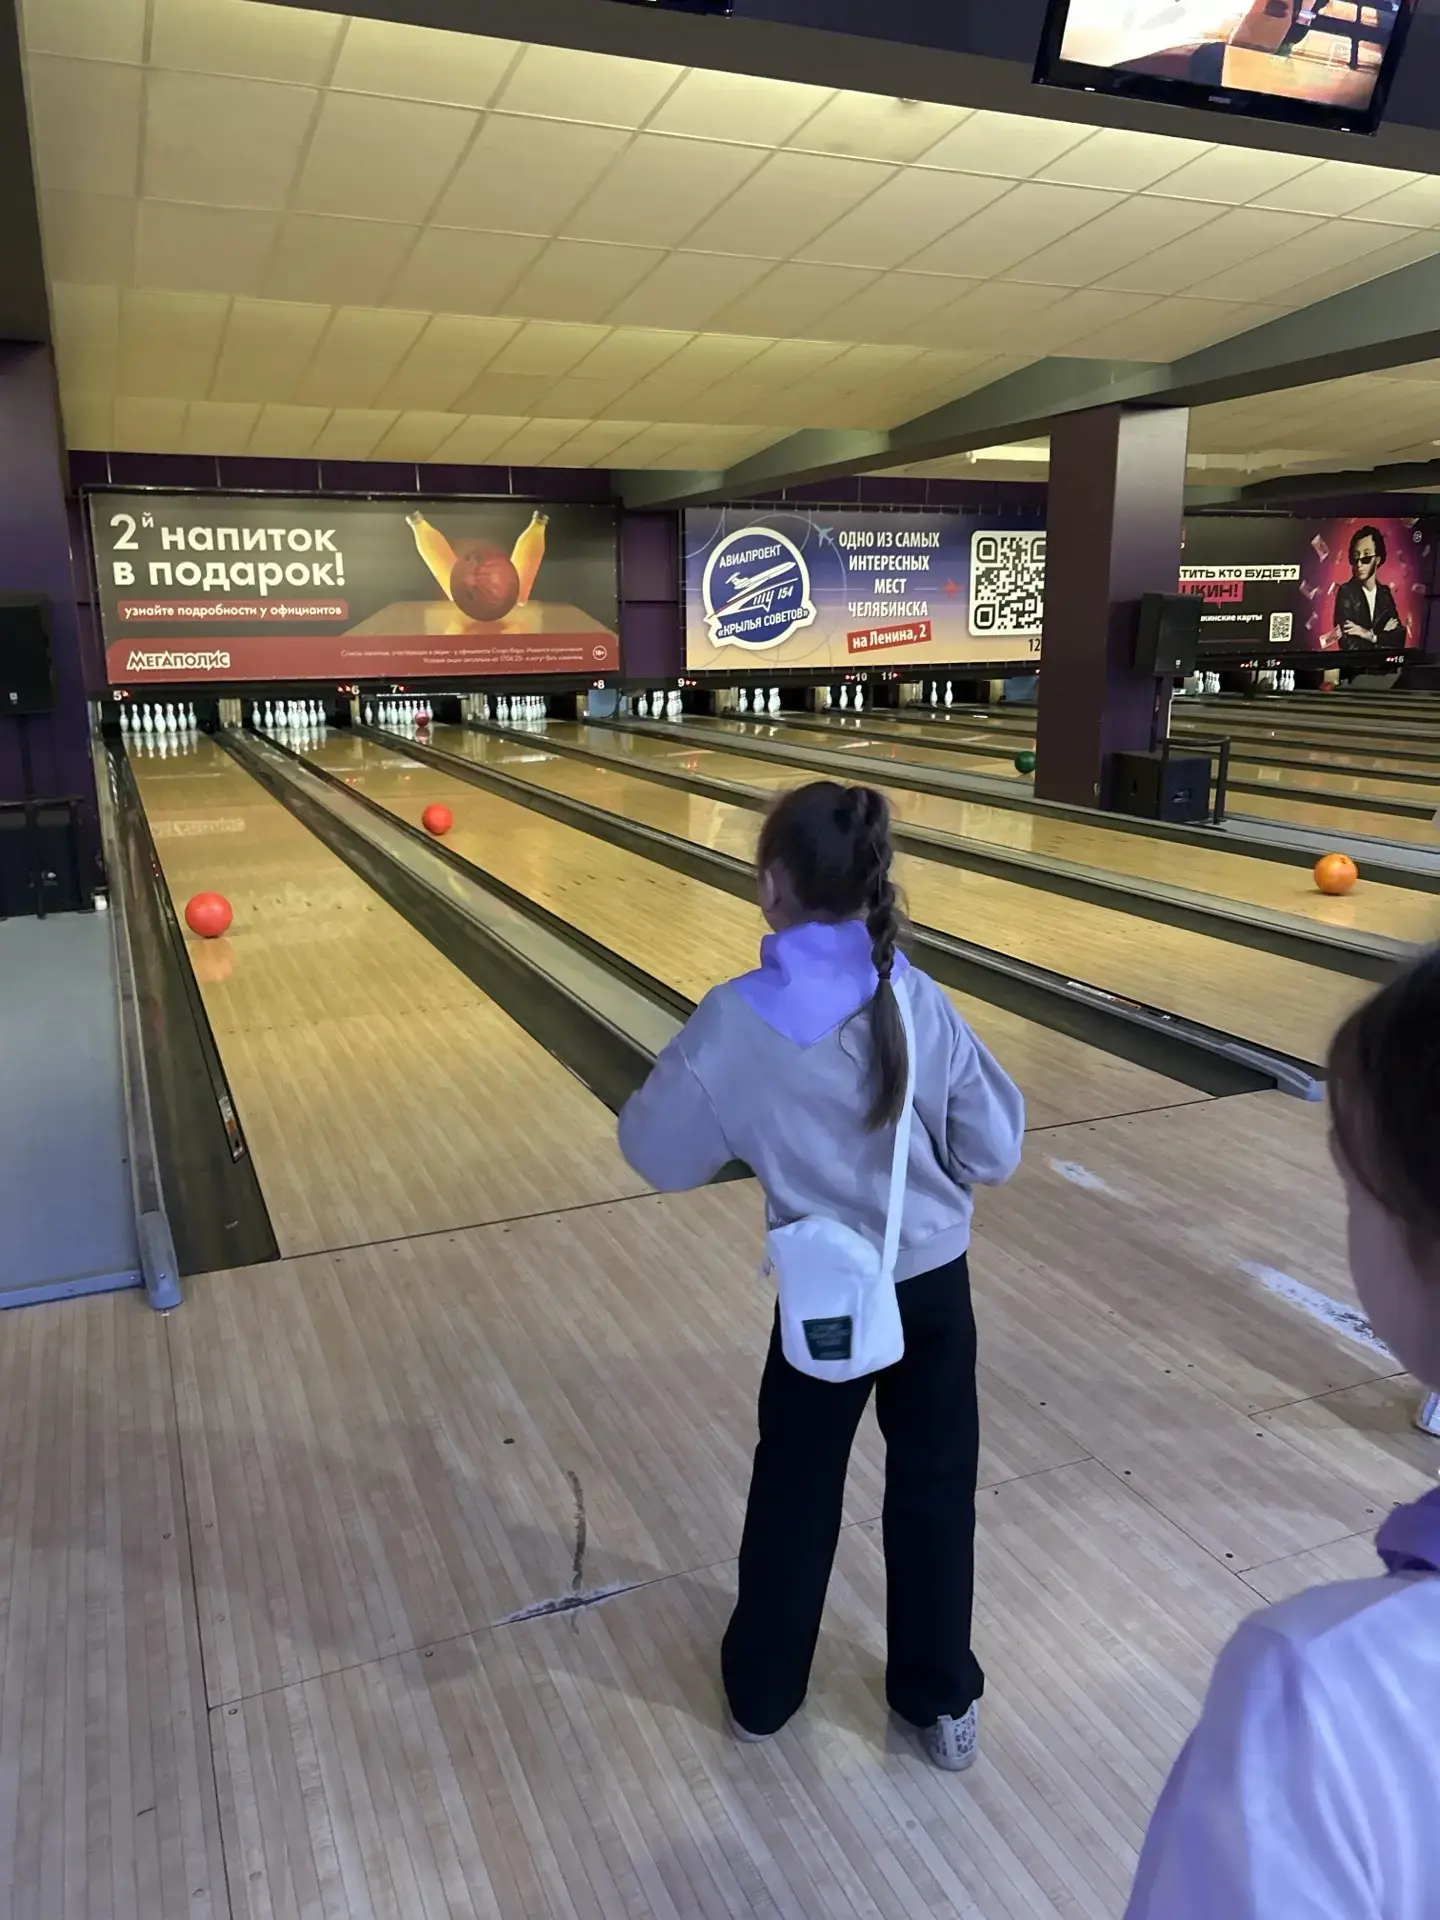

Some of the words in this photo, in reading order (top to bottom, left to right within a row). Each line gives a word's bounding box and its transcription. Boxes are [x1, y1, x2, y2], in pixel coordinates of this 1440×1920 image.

[161, 526, 338, 551] напиток
[838, 531, 875, 551] ОДНО
[876, 531, 893, 548] ИЗ
[894, 531, 940, 548] САМЫХ
[719, 544, 782, 569] АВИАПРОЕКТ
[849, 555, 930, 571] ИНТЕРЕСНЫХ
[112, 561, 136, 586] в
[148, 552, 346, 596] подарок!
[1179, 569, 1216, 578] ТИТЬ
[1218, 568, 1242, 578] КТО
[1244, 568, 1297, 578] БУДЕТ?
[777, 585, 794, 600] 154
[873, 578, 907, 594] МЕСТ
[124, 604, 175, 619] узнайте
[178, 603, 257, 619] подробности
[260, 606, 268, 618] у
[270, 604, 342, 618] официантов
[848, 601, 929, 617] ЧЕЛЯБИНСКА
[717, 616, 762, 637] «КРЫЛЬЯ
[763, 607, 809, 627] СОВЕТОВ»
[1237, 614, 1263, 623] карты
[852, 636, 868, 649] на
[868, 629, 918, 646] Ленина,
[918, 624, 927, 639] 2
[677, 678, 685, 688] 9
[855, 672, 868, 682] 10
[881, 671, 892, 681] 11
[351, 684, 360, 695] 6
[390, 684, 399, 694] 7
[597, 680, 605, 690] 8
[113, 690, 122, 701] 5
